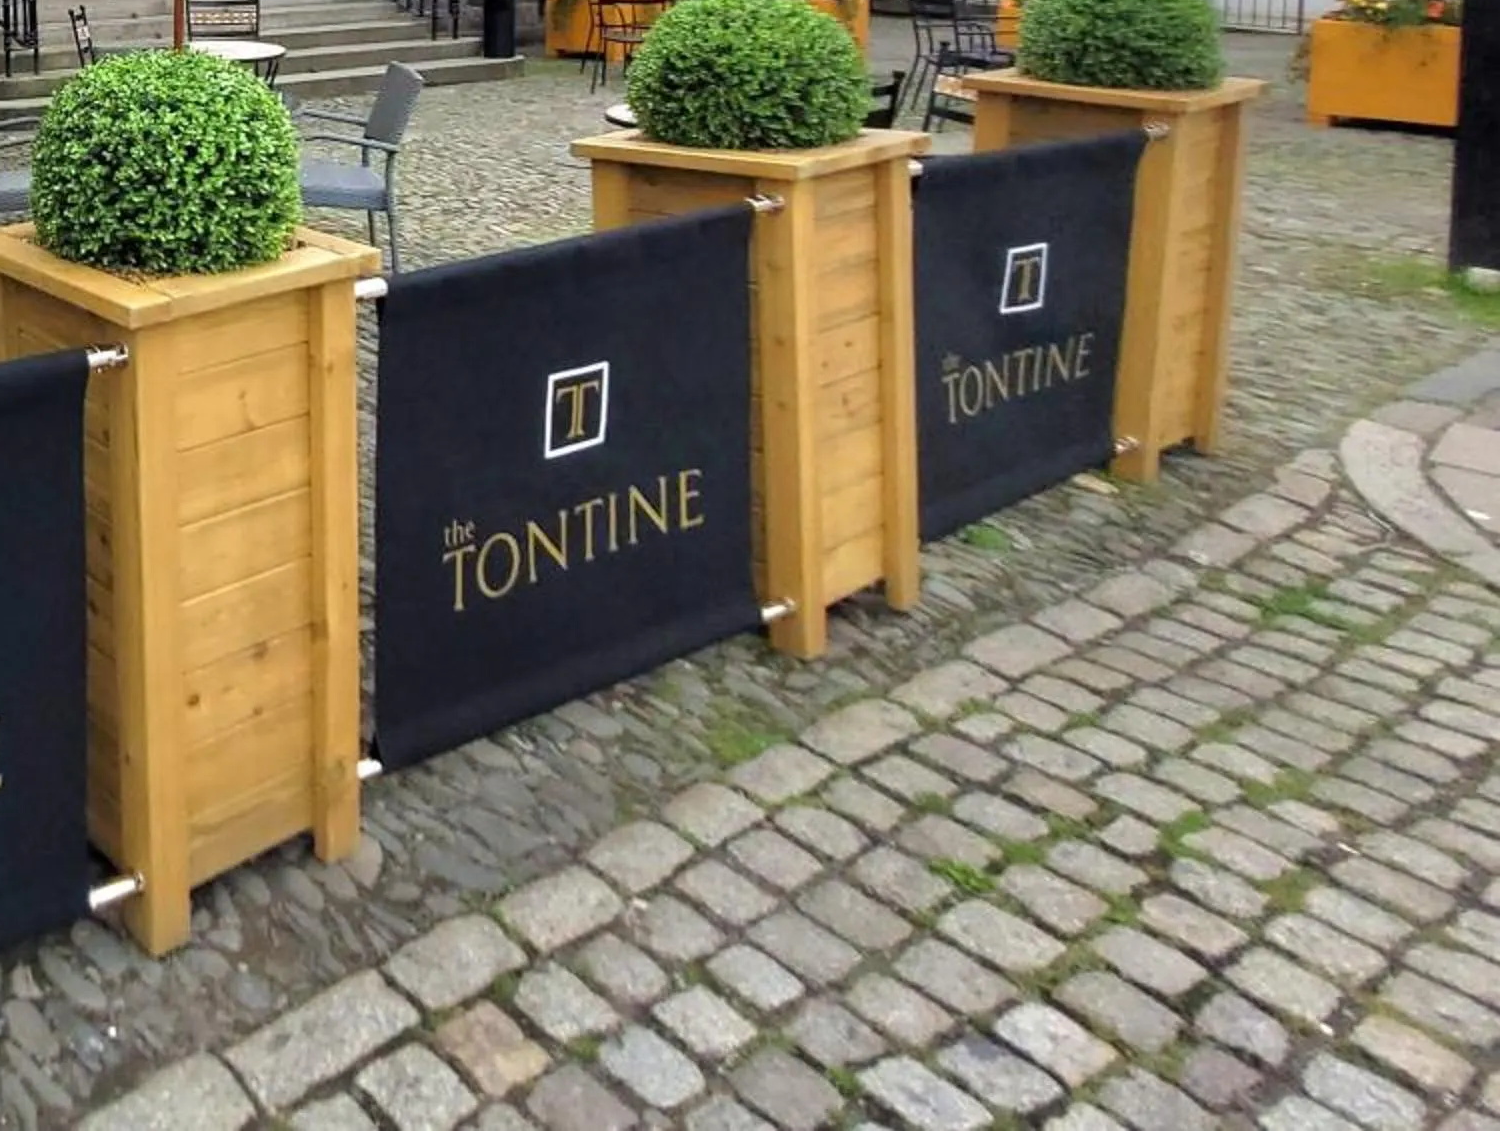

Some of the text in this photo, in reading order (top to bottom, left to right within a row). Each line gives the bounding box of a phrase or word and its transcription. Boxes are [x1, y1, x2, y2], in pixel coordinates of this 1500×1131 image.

[941, 335, 1095, 424] TONTINE
[442, 469, 704, 611] TONTINE
[444, 519, 476, 546] the
